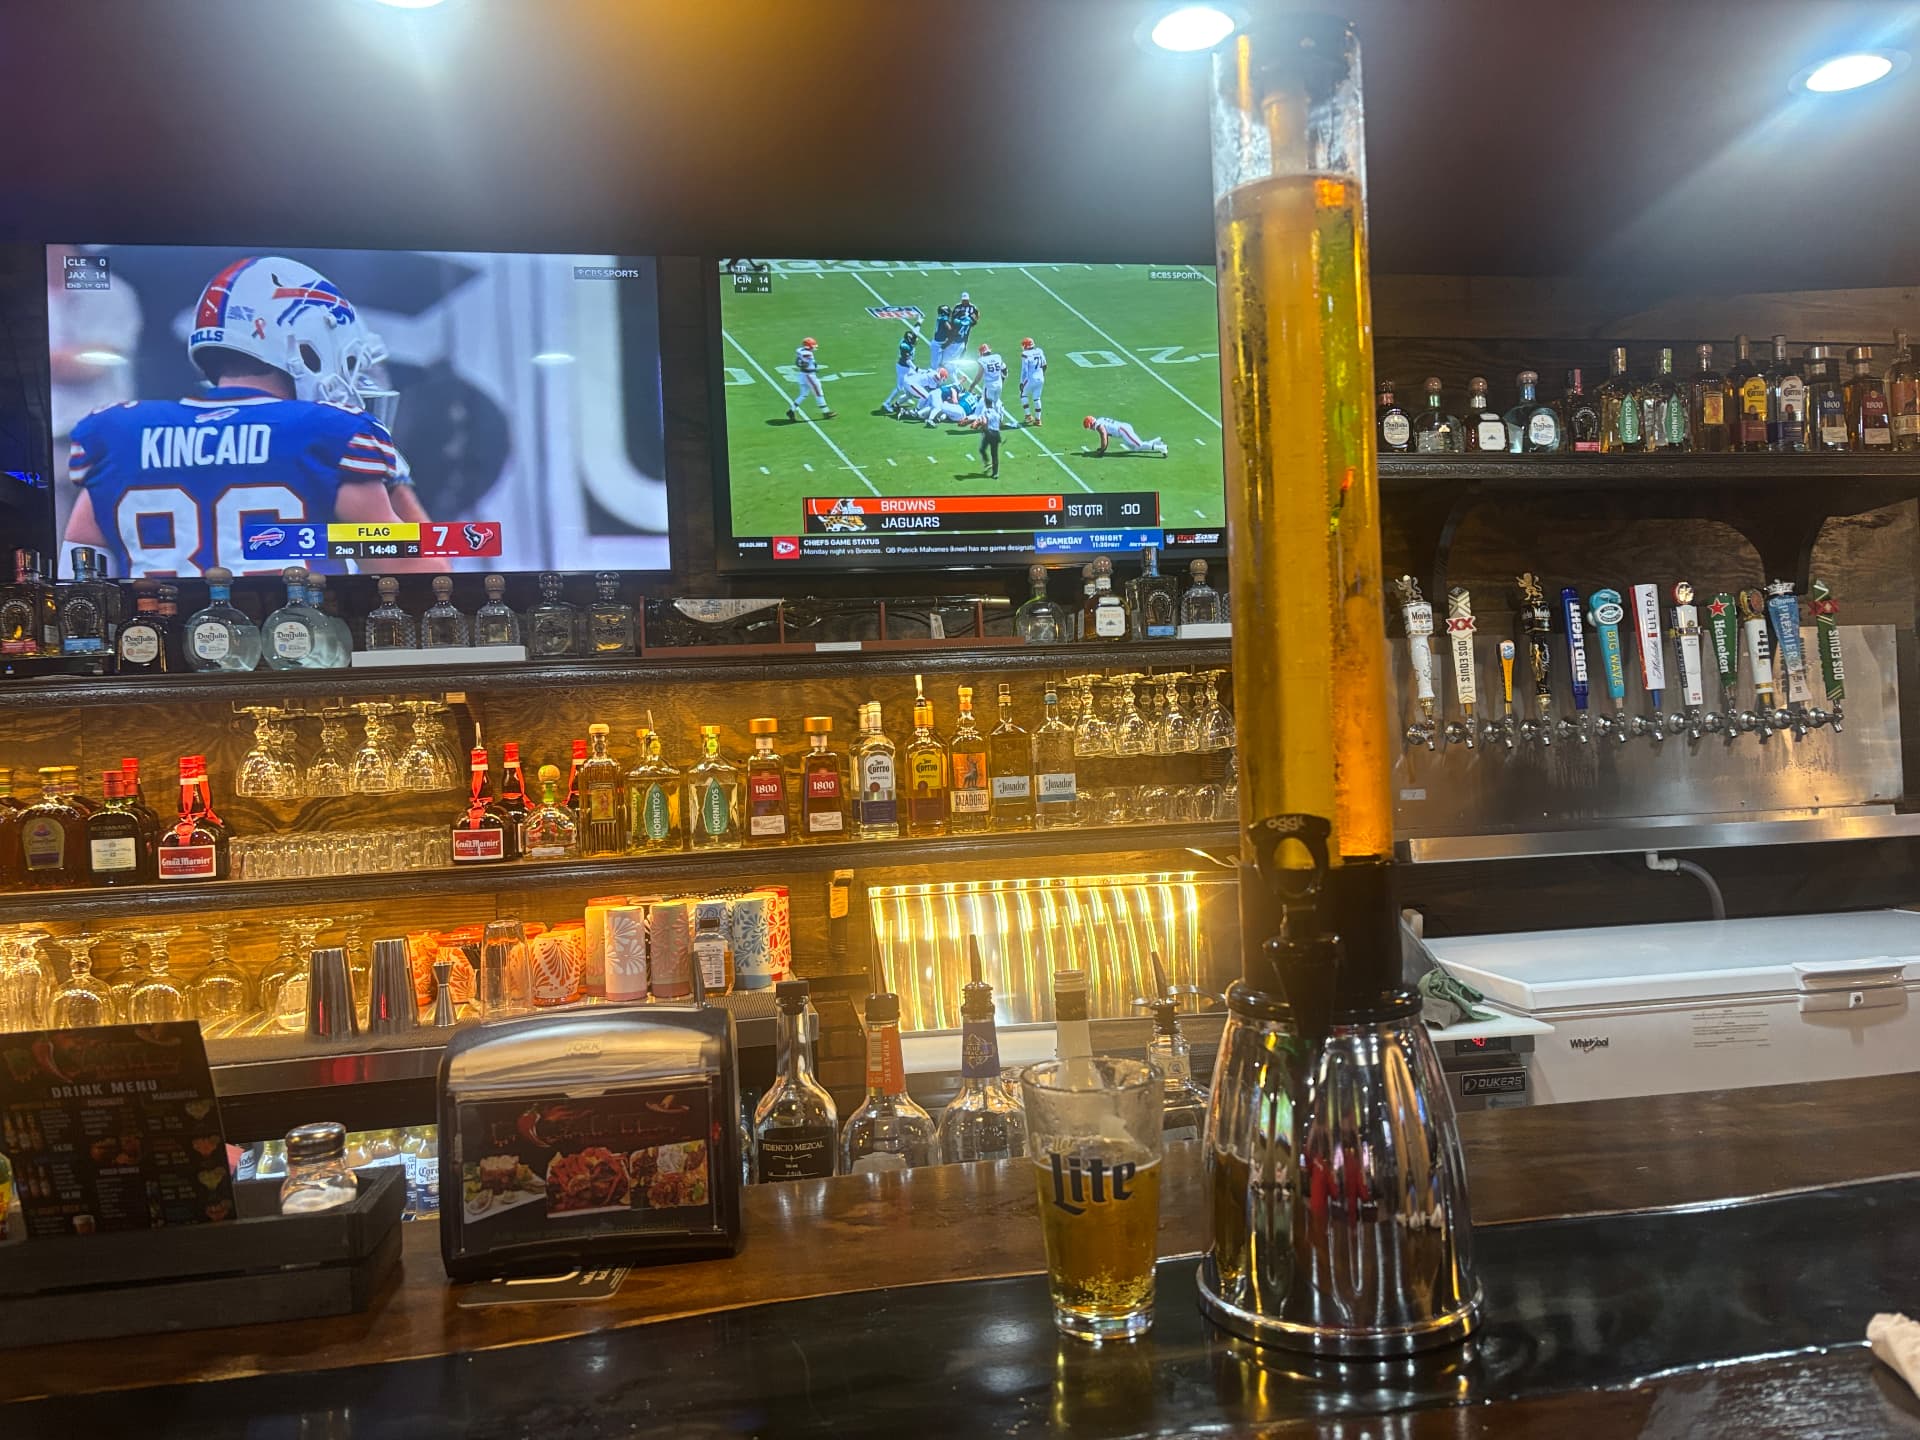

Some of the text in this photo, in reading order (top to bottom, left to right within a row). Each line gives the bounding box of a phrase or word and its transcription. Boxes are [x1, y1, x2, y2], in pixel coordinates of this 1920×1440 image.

[68, 258, 106, 267] CLE 0
[68, 271, 106, 280] JAX 14
[604, 269, 639, 278] SPORTS
[736, 276, 769, 284] CIN 14
[1156, 271, 1201, 279] CBS SPORTS
[1823, 401, 1840, 409] 1800
[1866, 401, 1884, 409] 1800
[1671, 400, 1679, 443] HORNITOS
[140, 421, 271, 470] KINCAID
[881, 498, 1057, 512] BROWNS 0
[1067, 504, 1103, 518] 1ST QTR
[881, 514, 1058, 529] JAGUARS 14
[298, 528, 316, 549] 3
[357, 526, 391, 538] FLAG
[432, 526, 449, 547] 7
[1090, 534, 1124, 542] TONIGHT
[830, 538, 851, 546] GAME
[1046, 536, 1083, 546] GAMEDAY
[369, 543, 398, 555] 14:48
[407, 544, 419, 553] 25
[803, 547, 828, 555] Monday
[829, 548, 845, 556] night
[885, 546, 897, 554] QB
[897, 545, 919, 553] Patrick
[919, 544, 949, 553] Mahomes
[1644, 590, 1658, 631] ULTRA
[1446, 617, 1477, 633] XX
[1777, 603, 1798, 658] PREMIER
[1569, 601, 1588, 682] BUD LIGHT
[1606, 630, 1617, 649] BIG
[1713, 620, 1730, 674] Heineken
[1458, 640, 1471, 682] DOS EQUIS
[1828, 629, 1845, 680] DOS EQUIS
[1609, 654, 1623, 687] WAVE
[755, 783, 778, 794] 1800
[813, 781, 835, 791] 1800
[999, 780, 1027, 794] Jimador
[1046, 777, 1073, 791] Jimador
[653, 792, 661, 837] HORNITOS
[711, 788, 721, 834] HORNITOS
[1266, 816, 1305, 832] oggi
[161, 855, 213, 867] Grand Marnier
[50, 1079, 159, 1100] DRINK MENU
[1478, 1076, 1521, 1089] DUKERS
[762, 1140, 824, 1152] FIDENCIO MEZCAL
[1046, 1149, 1136, 1216] Lite
